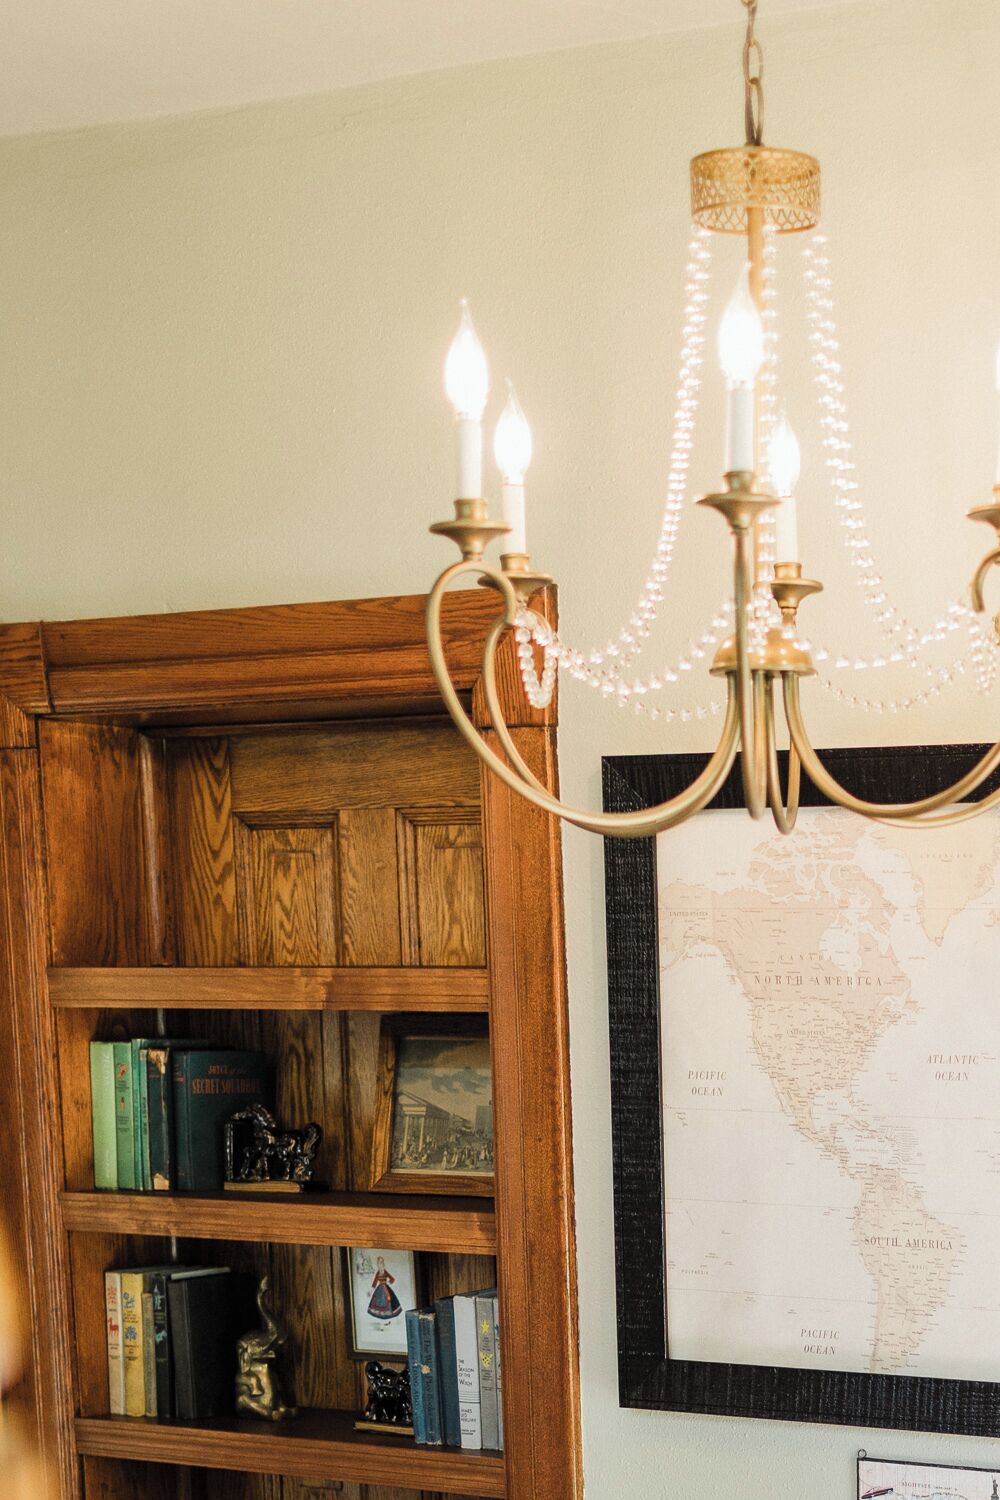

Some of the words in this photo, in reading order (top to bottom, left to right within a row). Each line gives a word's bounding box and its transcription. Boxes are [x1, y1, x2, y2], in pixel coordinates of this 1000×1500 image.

[754, 975, 803, 986] NORTH
[815, 976, 882, 986] AMERICA
[928, 1055, 979, 1065] ATLANTIC
[688, 1070, 727, 1080] PACIFIC
[935, 1071, 969, 1081] OCEAN
[192, 1078, 219, 1094] SECRET
[691, 1087, 724, 1097] OCEAN
[864, 1237, 898, 1247] SOUTH
[905, 1238, 953, 1250] AMERICA
[800, 1328, 840, 1339] PACIFIC
[804, 1344, 836, 1355] OCEAN
